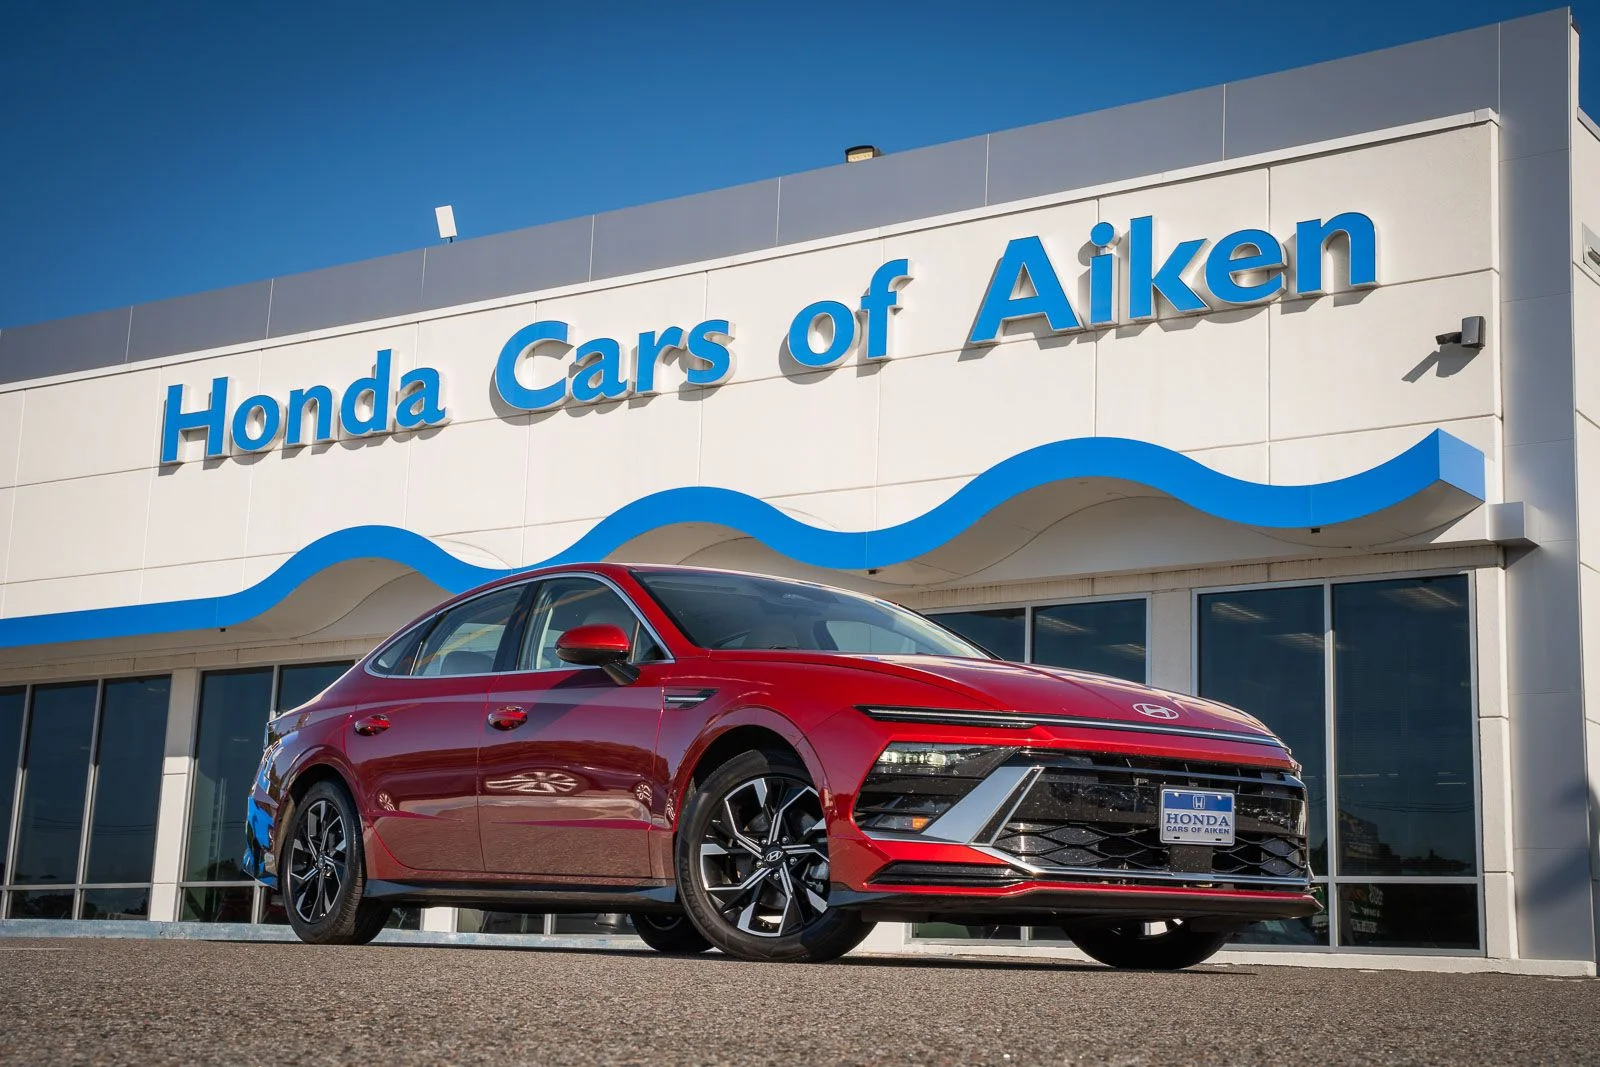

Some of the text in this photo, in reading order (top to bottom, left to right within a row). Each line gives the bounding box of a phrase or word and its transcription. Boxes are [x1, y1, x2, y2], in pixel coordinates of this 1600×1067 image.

[163, 212, 1377, 463] Honda Cars of Aiken
[1166, 813, 1231, 827] HONDA
[1166, 825, 1189, 833] CARS
[1204, 827, 1230, 835] AIKEN
